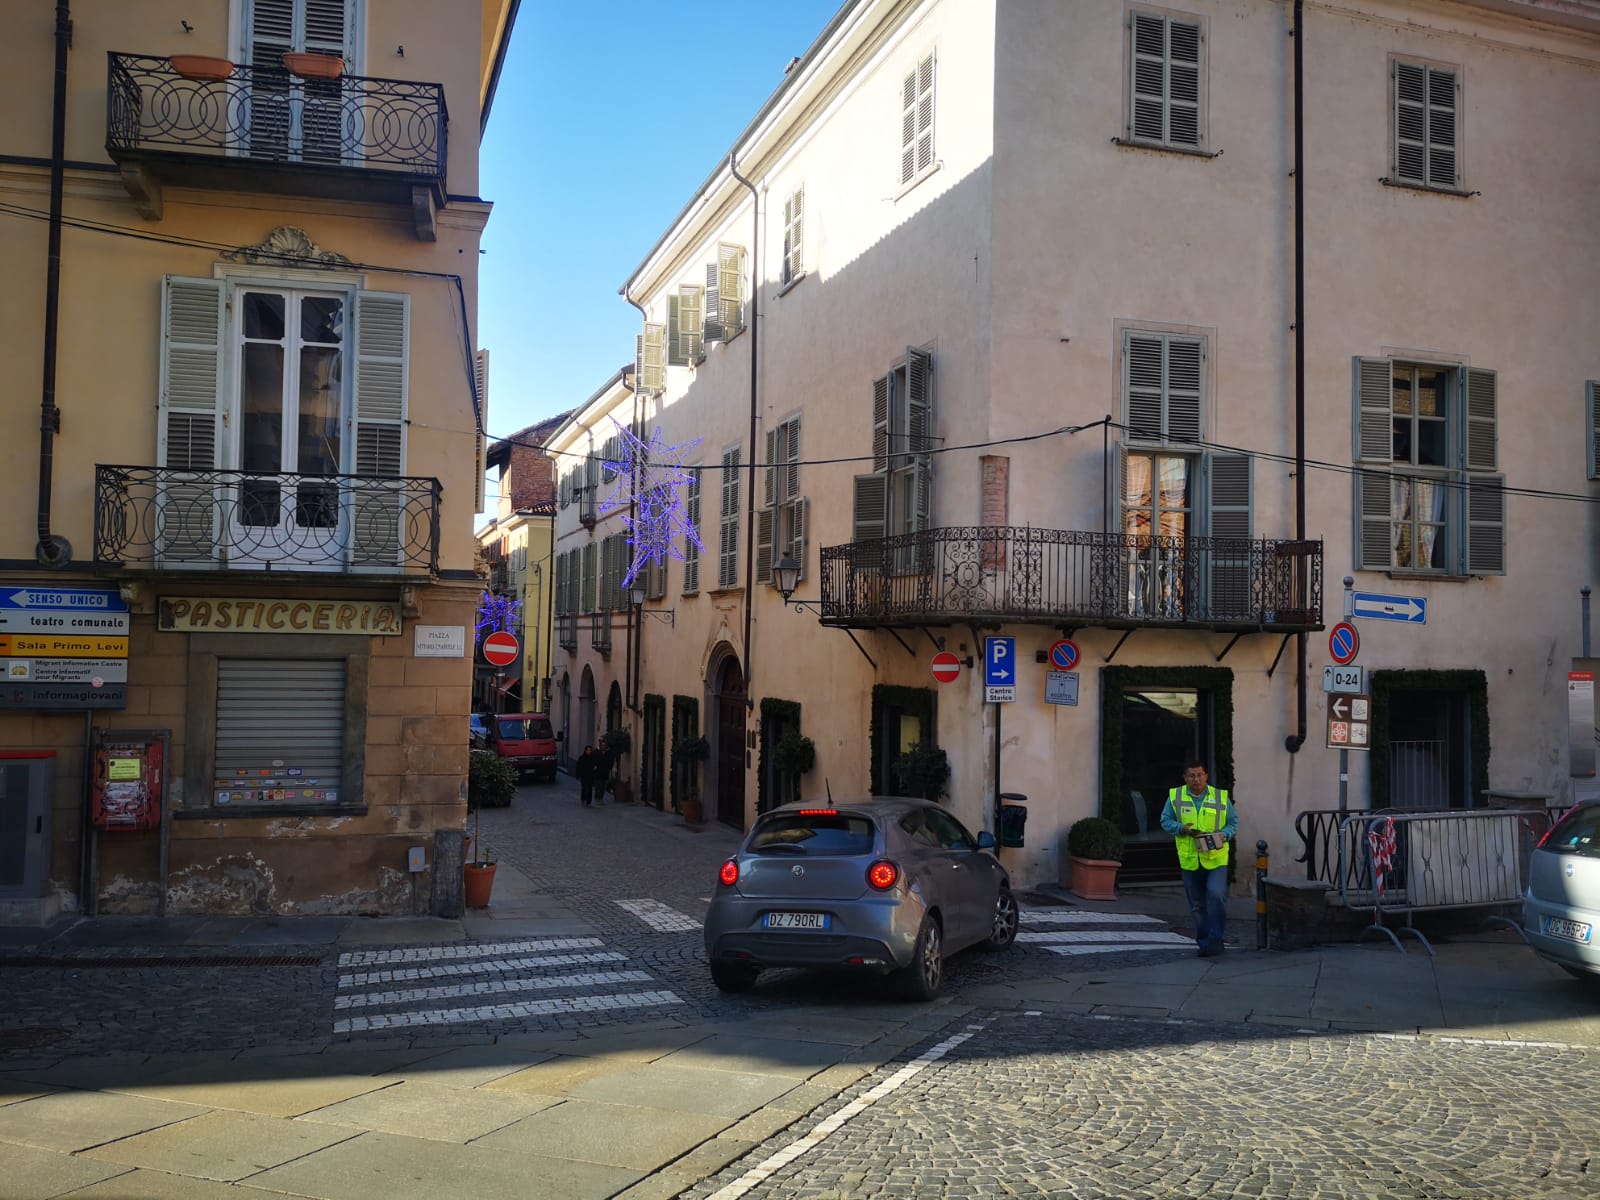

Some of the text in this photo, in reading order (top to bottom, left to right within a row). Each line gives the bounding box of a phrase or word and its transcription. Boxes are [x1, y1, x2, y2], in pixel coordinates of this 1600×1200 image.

[28, 593, 103, 606] SENSO UNICO
[30, 616, 124, 628] teatro comunale
[173, 600, 394, 631] PASTICCERIA
[428, 631, 450, 639] PIAZZA
[17, 641, 123, 651] Sala Primo Levi
[993, 644, 1007, 664] P
[1335, 672, 1358, 686] 0-24
[989, 694, 1013, 702] Storico
[769, 914, 822, 927] DZ 790RL
